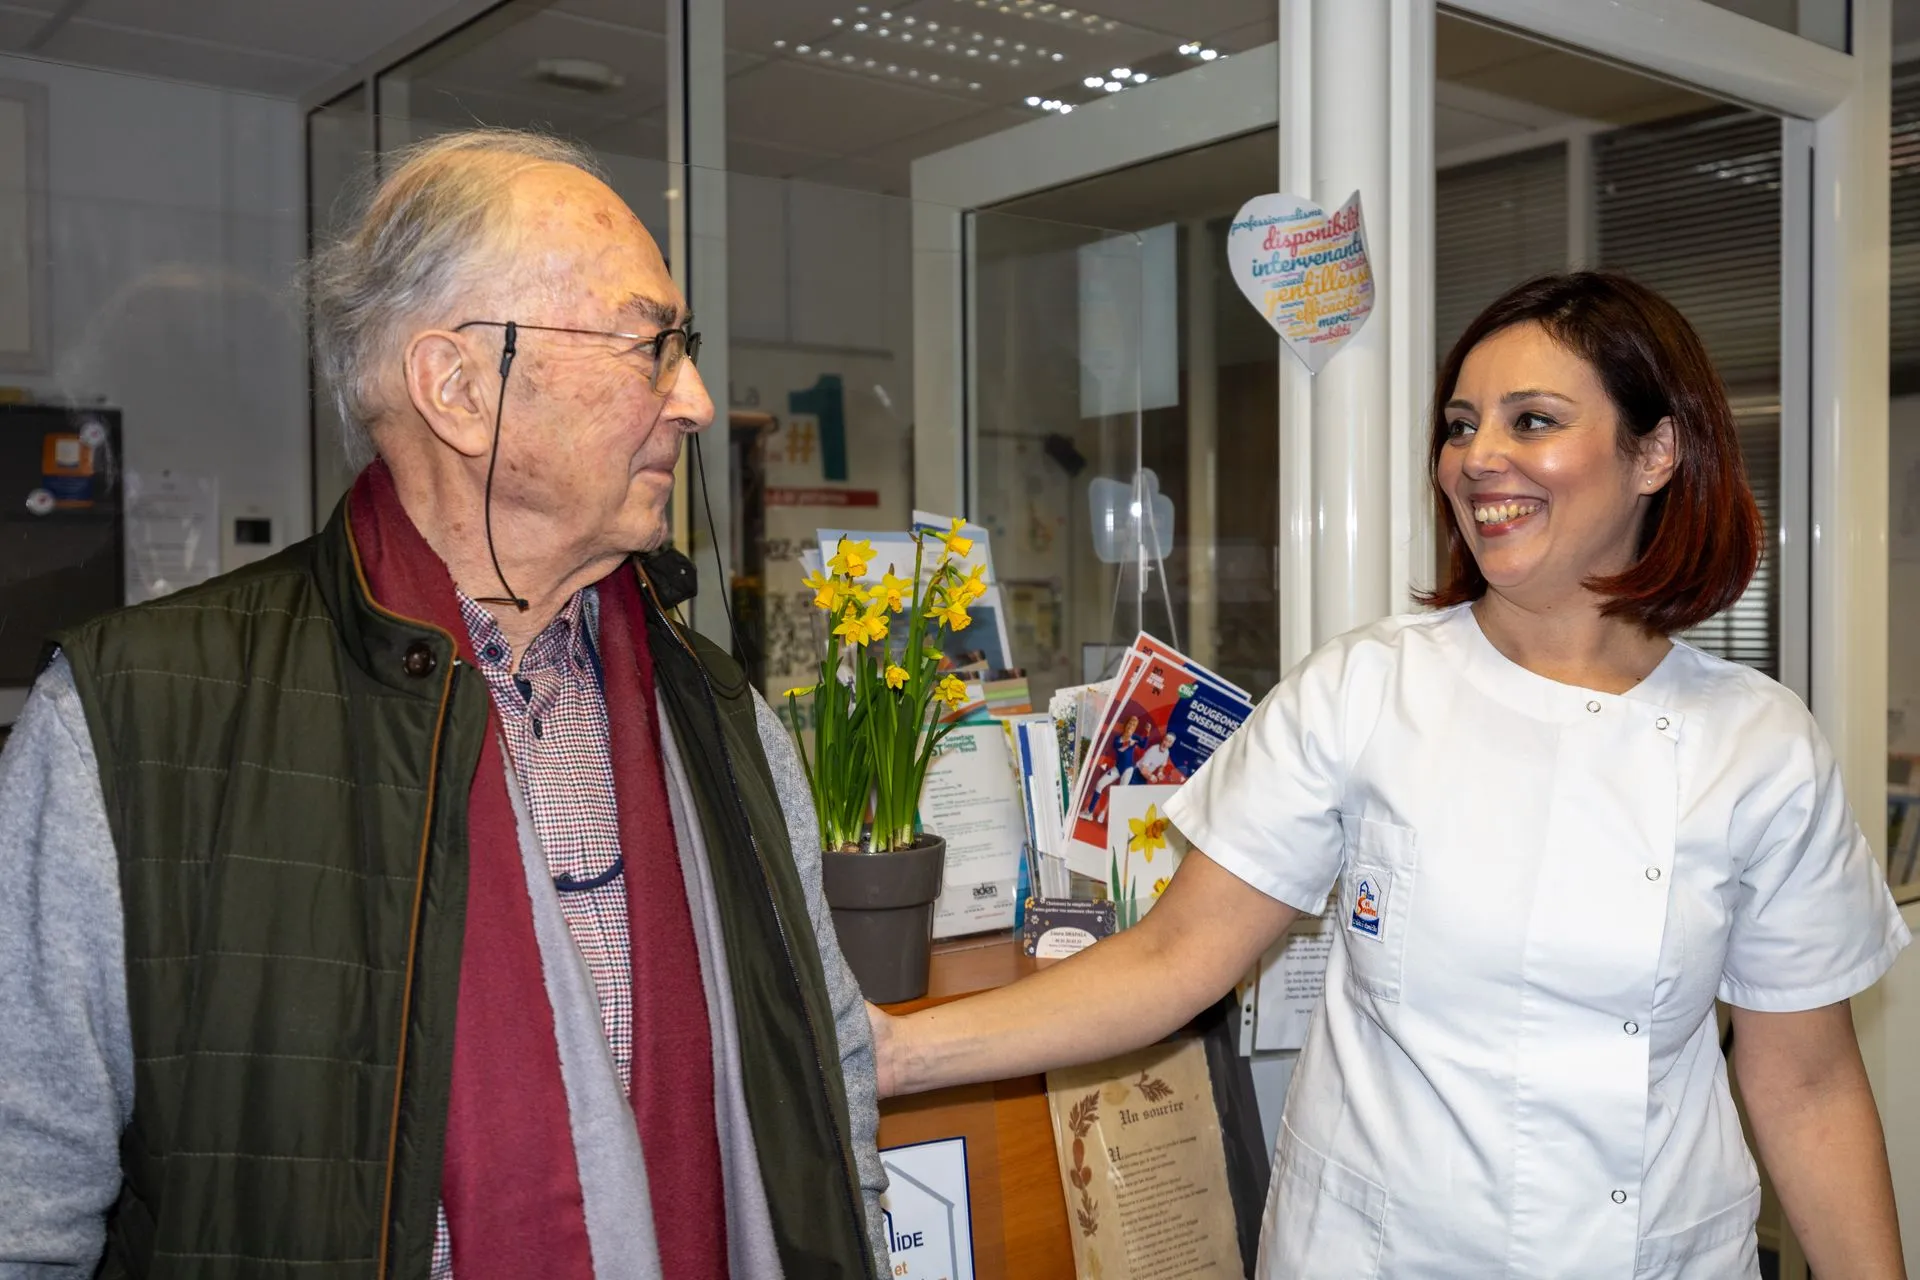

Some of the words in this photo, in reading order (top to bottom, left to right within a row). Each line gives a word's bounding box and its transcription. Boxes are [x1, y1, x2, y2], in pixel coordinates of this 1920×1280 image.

[1190, 699, 1241, 730] BOUGEONS
[1143, 1101, 1184, 1120] sourire
[894, 1261, 908, 1276] et
